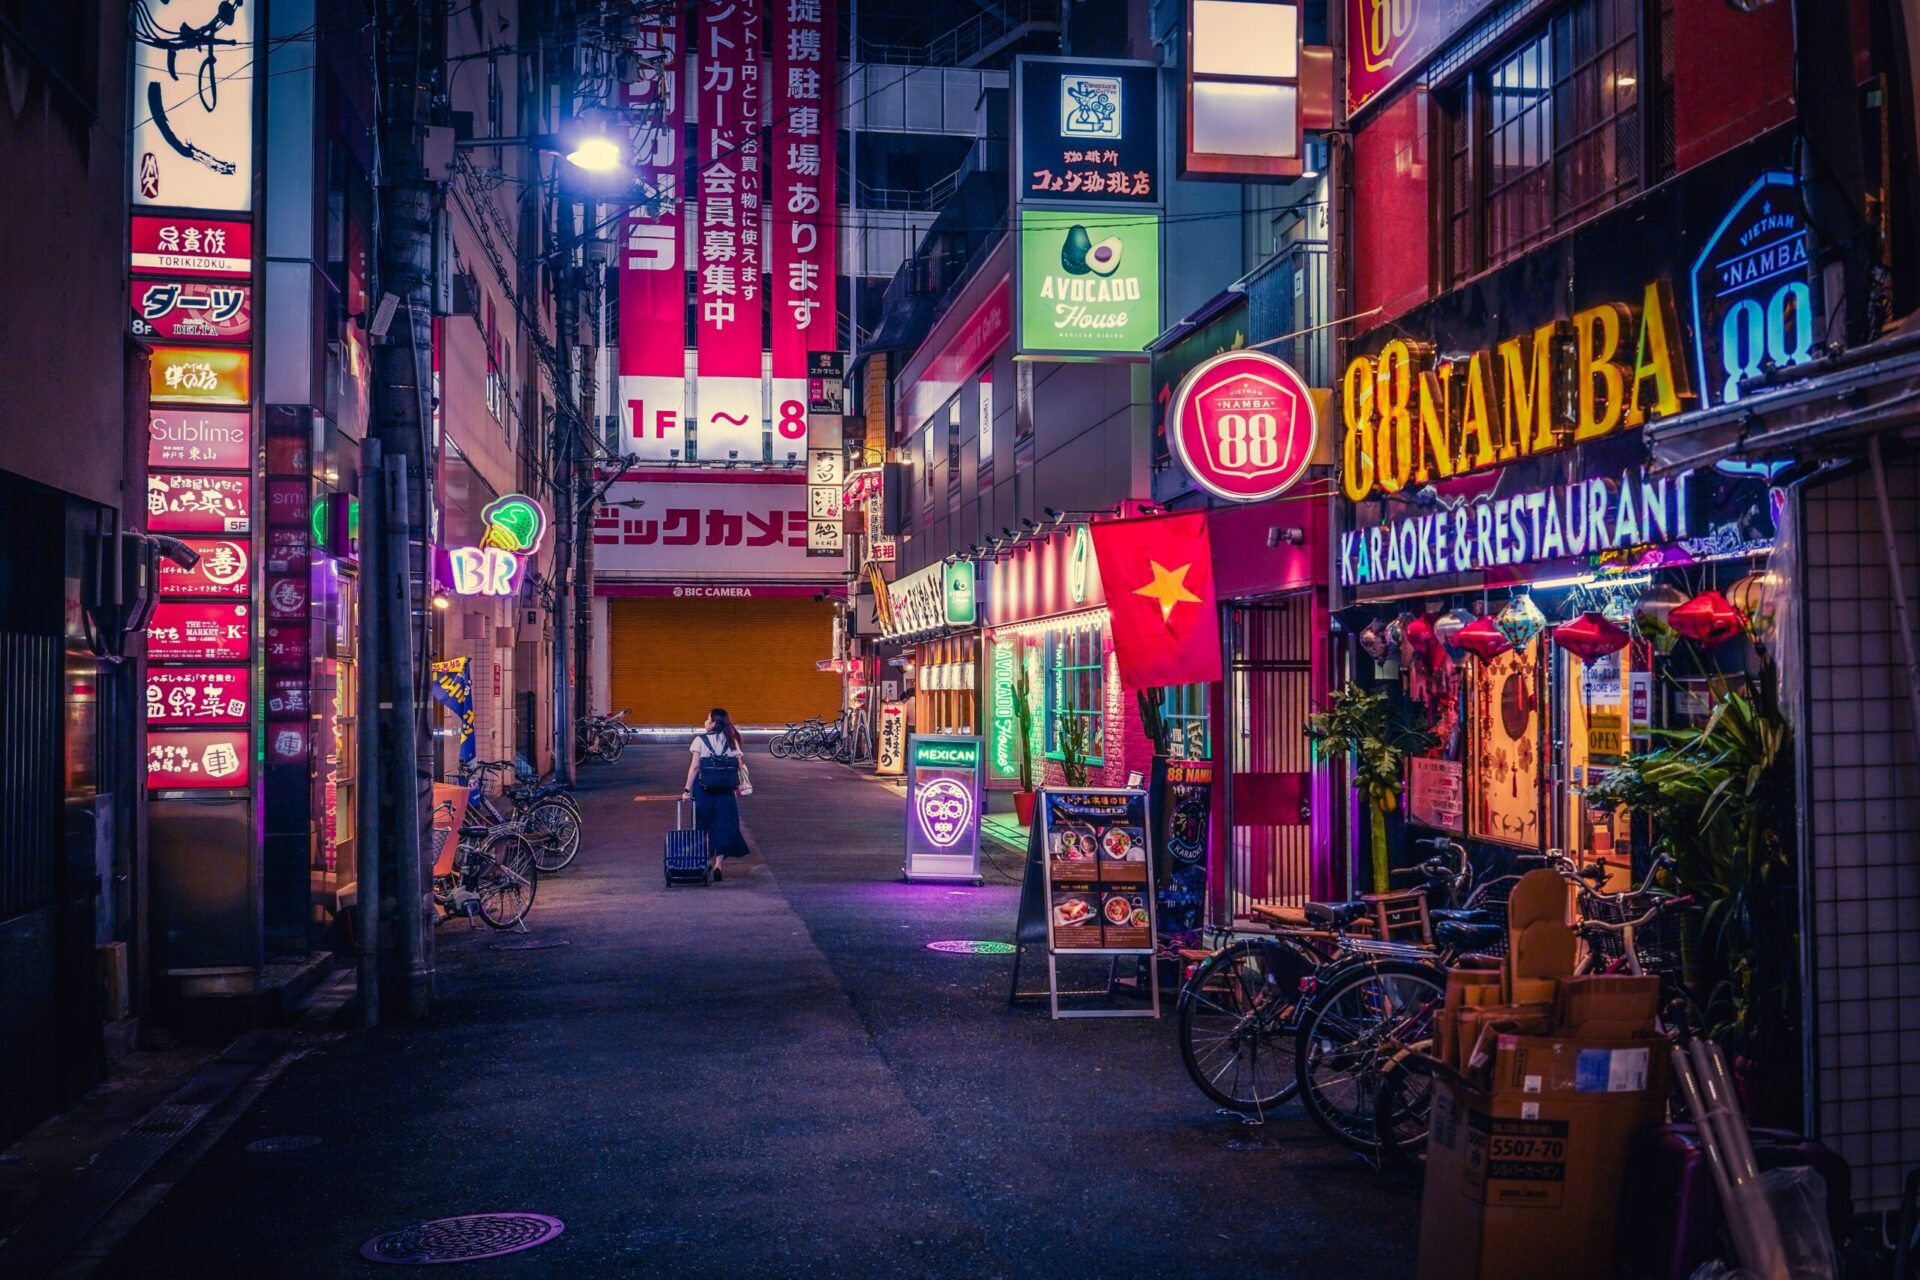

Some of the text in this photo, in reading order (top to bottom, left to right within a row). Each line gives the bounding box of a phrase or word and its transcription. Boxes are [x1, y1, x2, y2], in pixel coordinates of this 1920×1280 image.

[1031, 169, 1150, 195] コメダ珈琲店
[157, 225, 226, 254] 鳥貴族
[1740, 214, 1795, 246] VIETNAM
[158, 256, 226, 269] TORIKIZOKU
[1729, 239, 1807, 287] NAMBA
[1040, 276, 1141, 302] AVOCADO
[142, 283, 244, 322] ダーツ
[132, 320, 152, 334] 8F
[1054, 303, 1128, 329] House
[173, 324, 218, 336] DELTA
[1223, 399, 1271, 409] NAMBA
[1229, 387, 1264, 396] VIETNAM
[151, 418, 245, 443] Sublime
[1217, 413, 1278, 469] 88
[189, 446, 217, 461] 東山
[230, 521, 247, 530] 5F
[1341, 468, 1695, 587] KARAOKE & RESTAURANT
[205, 548, 241, 576] 善
[450, 546, 518, 596] BR
[232, 583, 247, 594] 4F
[684, 587, 752, 597] BIC CAMERA
[185, 628, 219, 636] MARKET
[994, 650, 1014, 718] AVOCADO
[996, 718, 1012, 773] House
[1590, 731, 1620, 751] OPEN
[208, 749, 228, 774] 車
[918, 749, 975, 761] MEXICAN
[1166, 767, 1183, 782] 88
[1491, 1139, 1564, 1158] 5507-70
